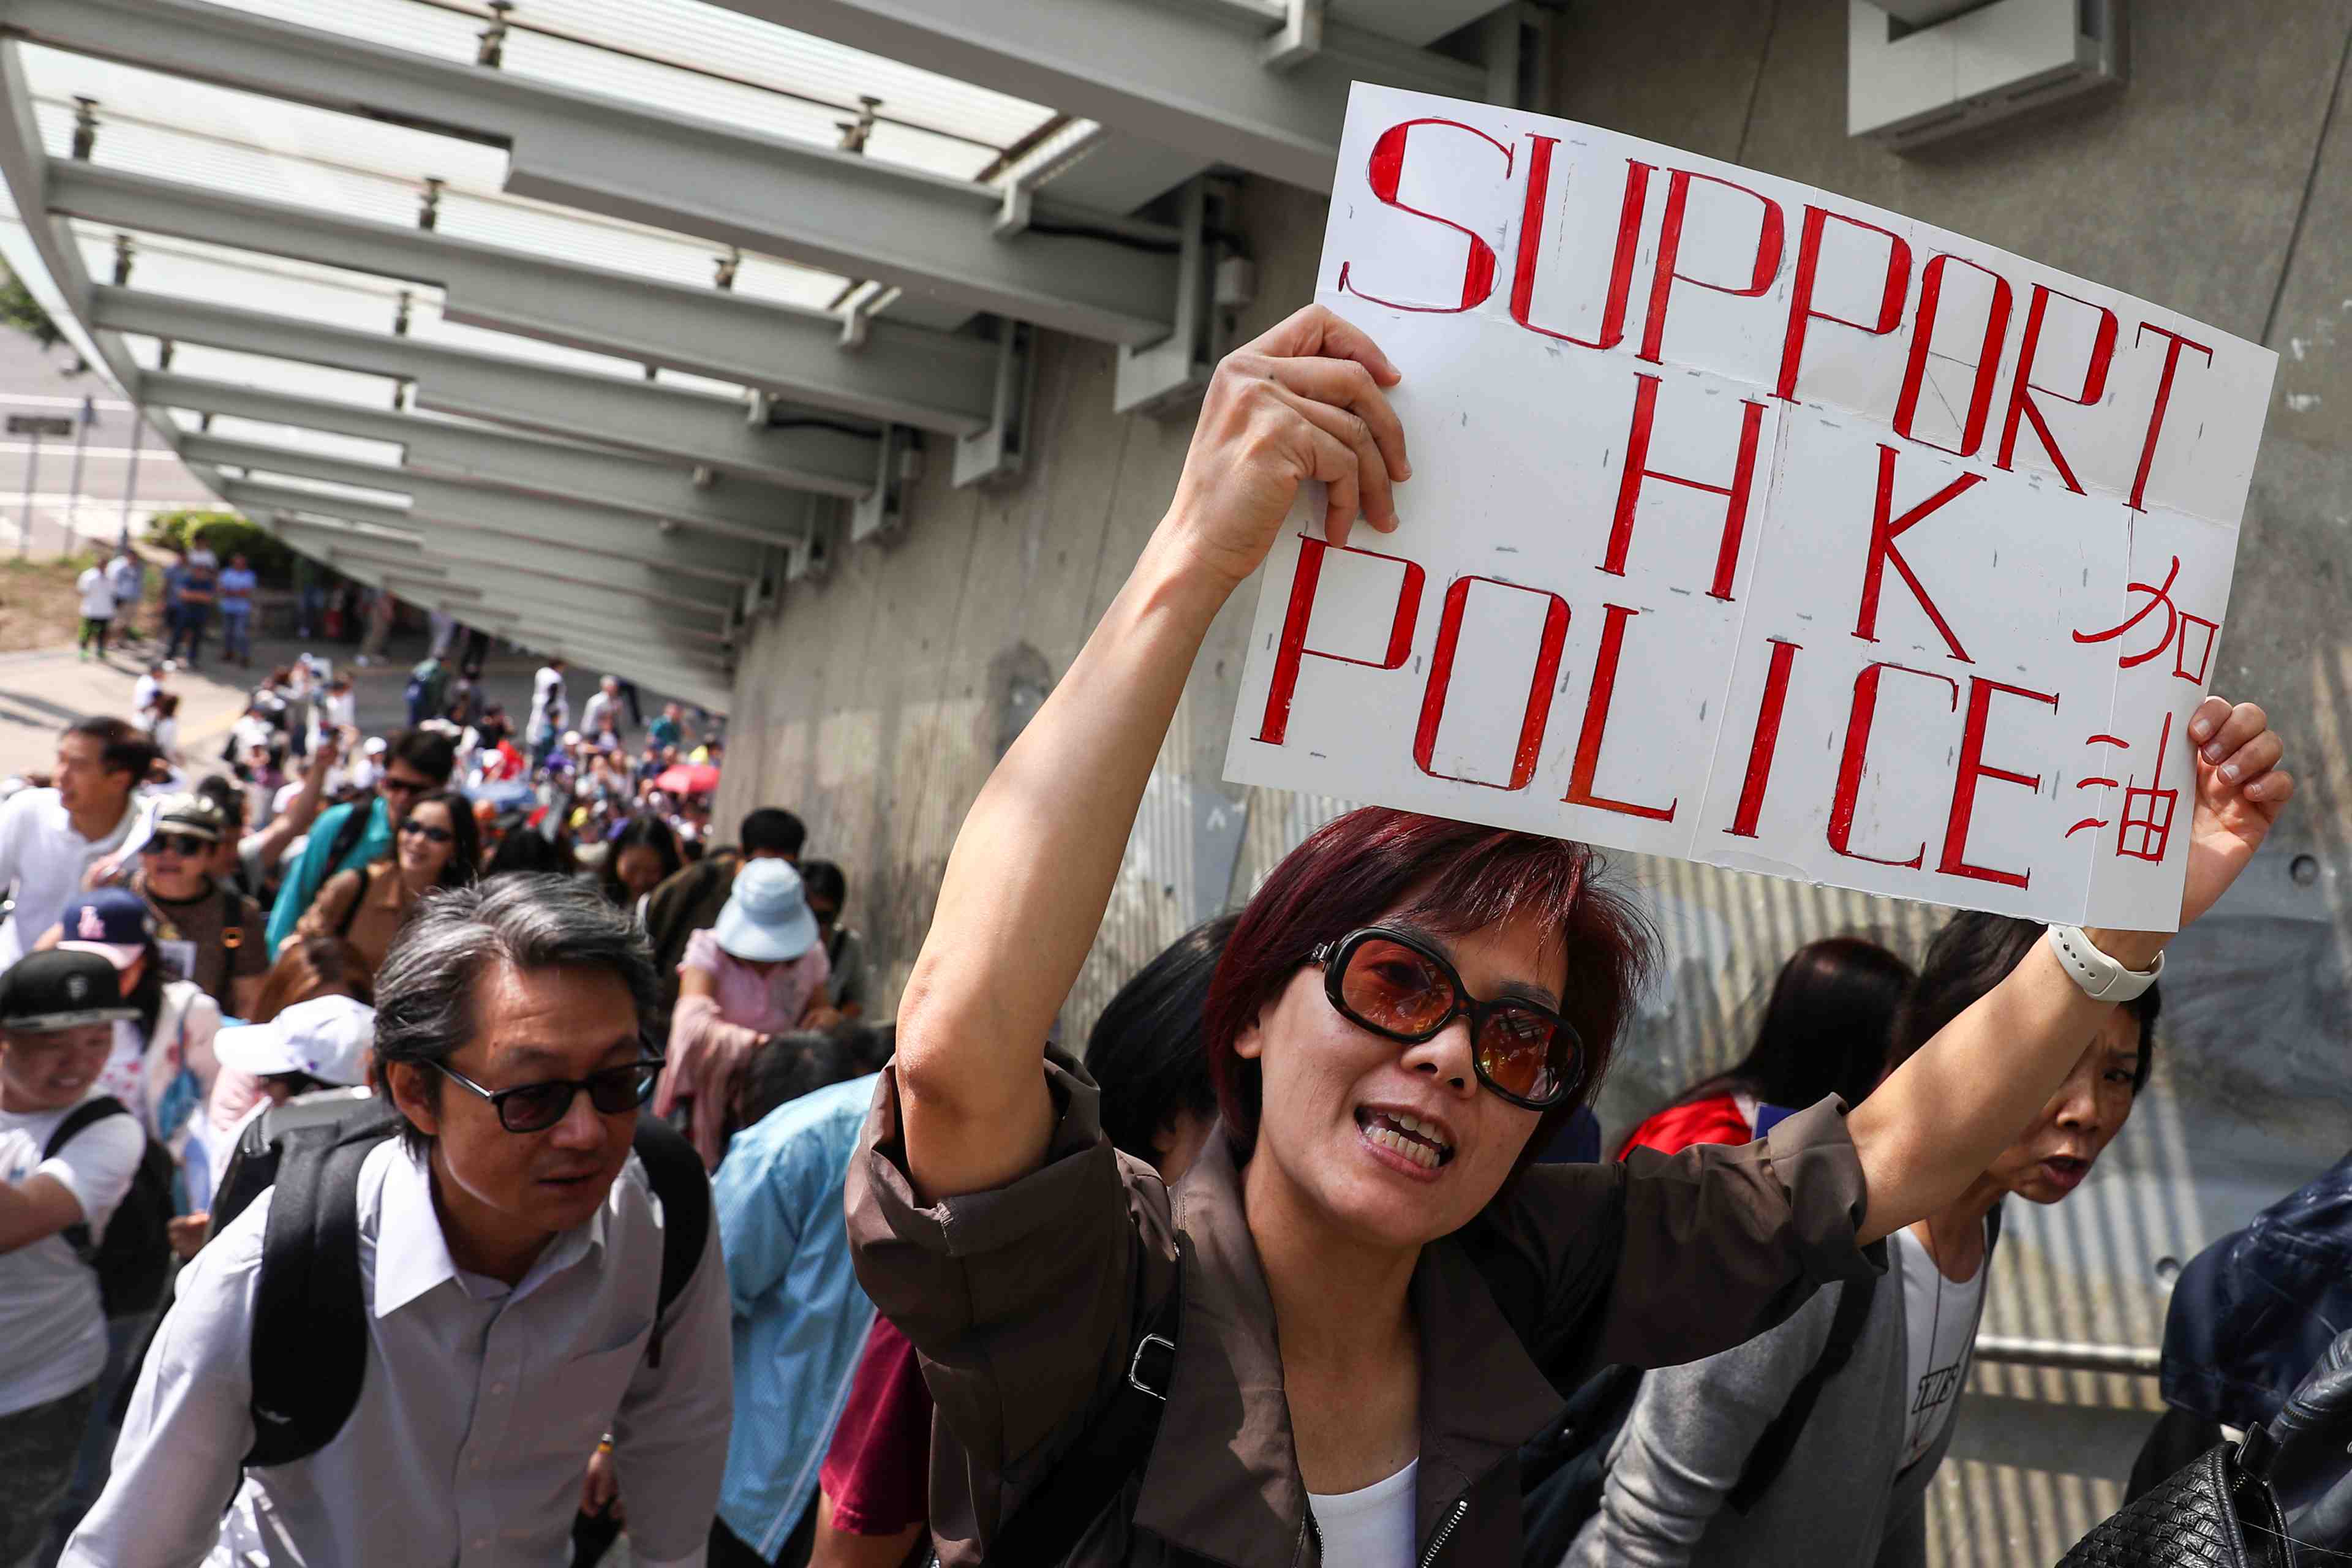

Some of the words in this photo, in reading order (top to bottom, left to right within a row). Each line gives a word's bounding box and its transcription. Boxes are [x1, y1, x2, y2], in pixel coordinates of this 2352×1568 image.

[1338, 118, 2214, 513] SUPPORT
[1250, 531, 2060, 891] POLICE
[2065, 554, 2220, 867] 加油
